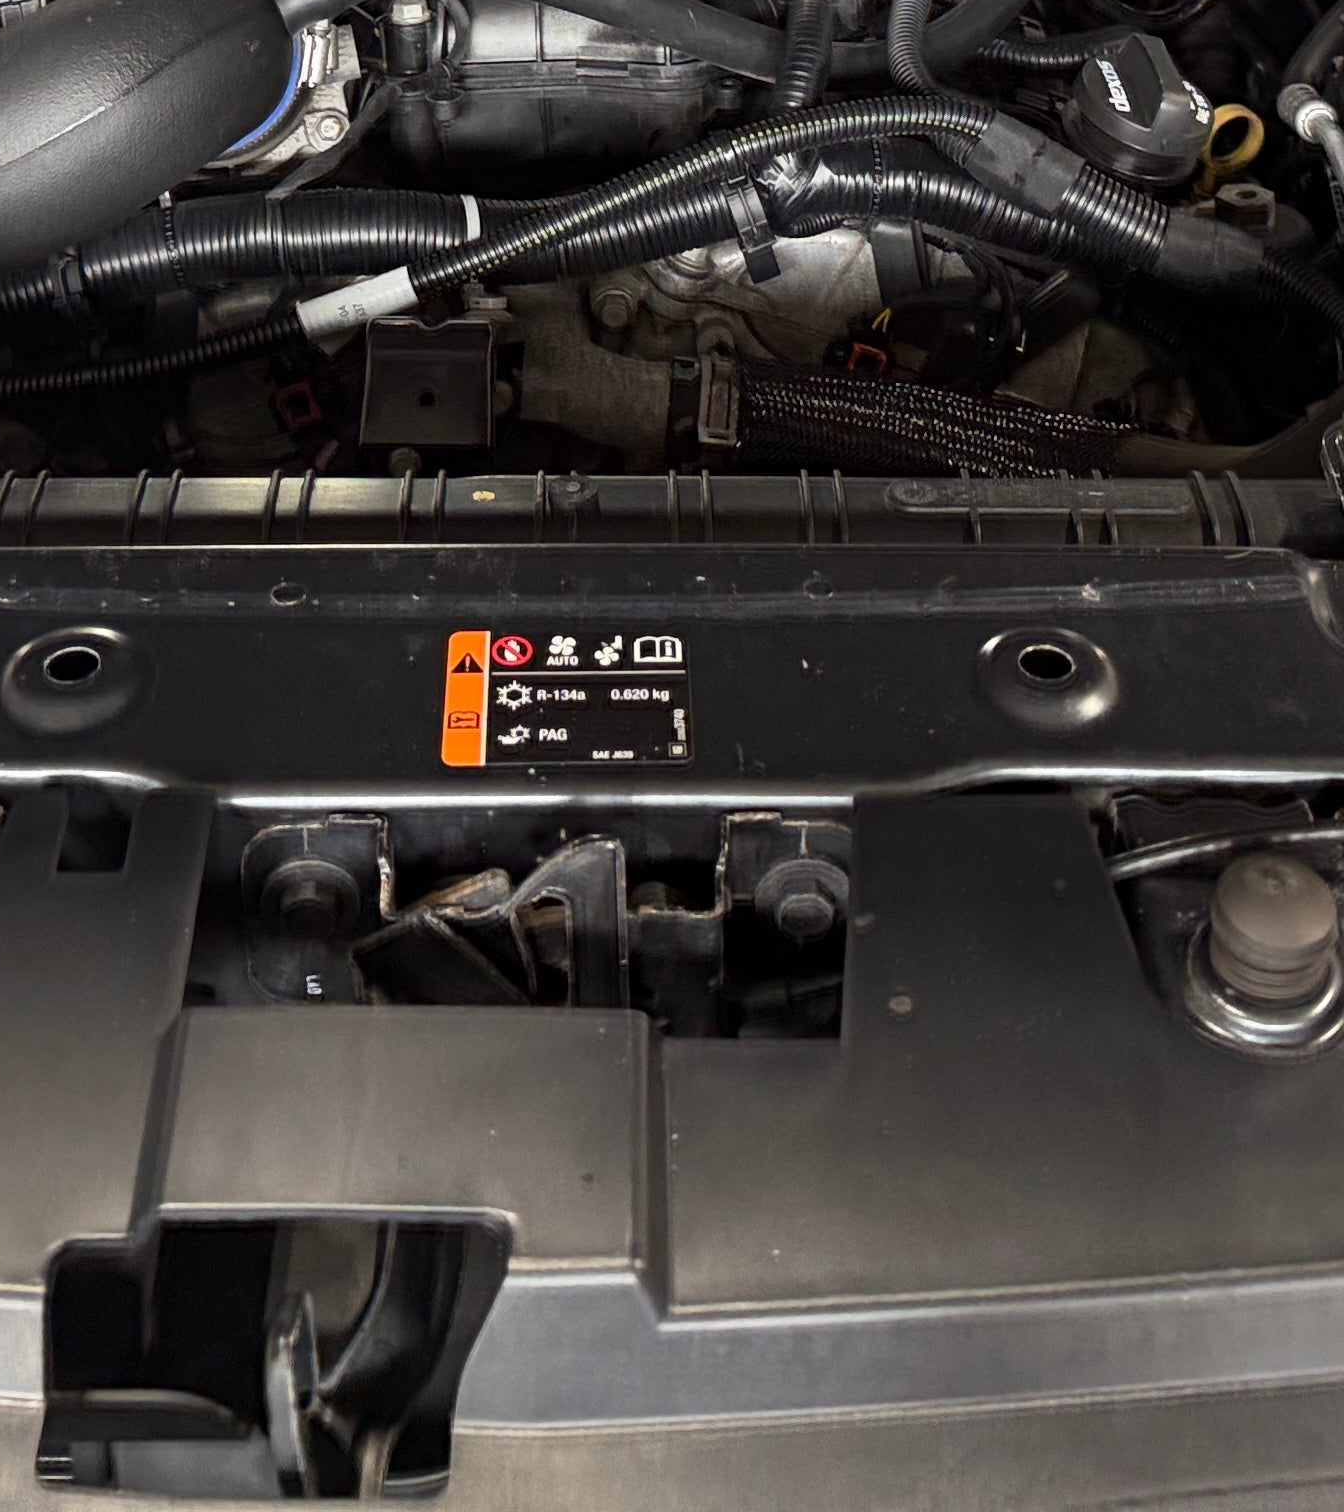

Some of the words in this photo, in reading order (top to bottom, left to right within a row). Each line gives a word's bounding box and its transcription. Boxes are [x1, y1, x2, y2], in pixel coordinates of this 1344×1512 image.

[1096, 57, 1131, 113] dexos
[547, 655, 579, 666] AUTO
[536, 689, 586, 701] R-134a
[610, 689, 649, 701] 0.620
[652, 688, 670, 702] kg
[538, 728, 568, 741] PAG
